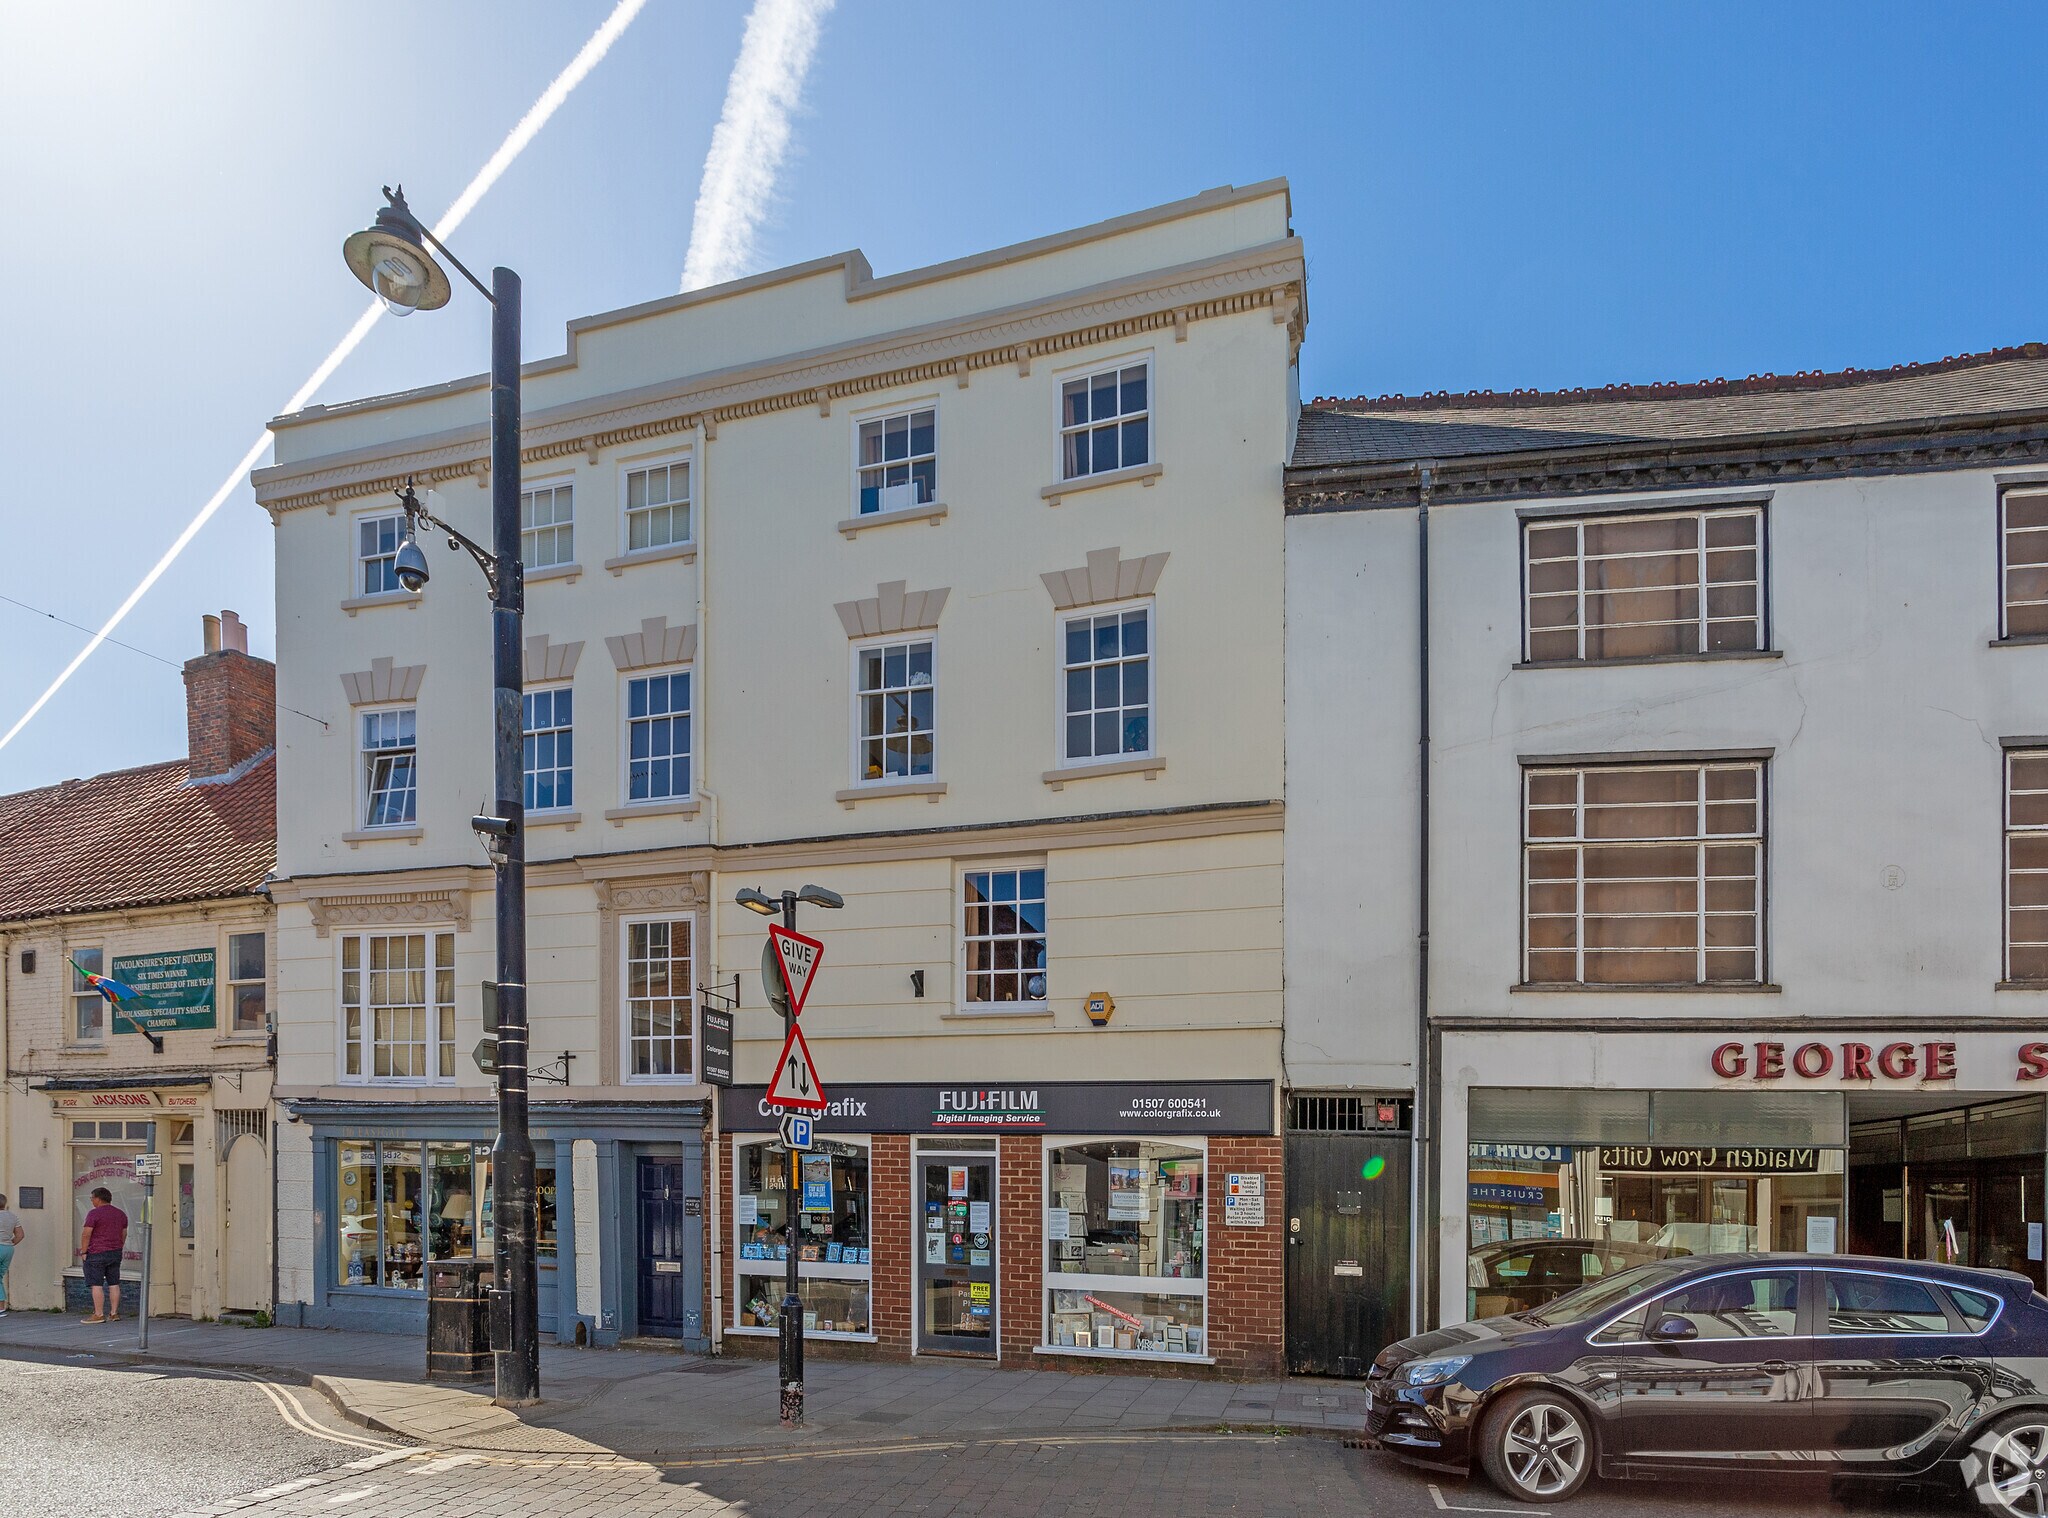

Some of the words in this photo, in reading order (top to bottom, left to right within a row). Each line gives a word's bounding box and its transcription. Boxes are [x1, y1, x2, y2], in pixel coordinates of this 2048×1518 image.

[781, 939, 812, 964] GIVE
[114, 957, 164, 970] LINCOLNSHIRE'S
[164, 956, 181, 966] BEST
[182, 952, 214, 964] BUTCHER
[137, 972, 147, 980] SIX
[147, 971, 164, 979] TIMES
[164, 969, 188, 978] WINNER
[788, 961, 808, 978] WAY
[151, 981, 177, 990] BUTCHER
[199, 977, 214, 986] YEAR
[153, 1006, 186, 1017] SPECIALITY
[185, 1004, 211, 1014] SAUSAGE
[1090, 1001, 1104, 1010] ADT
[146, 1018, 177, 1028] CHAMPION
[706, 1044, 730, 1056] Colorgrafix
[1711, 1042, 1958, 1081] GEORGE
[92, 1093, 151, 1106] JACKSONS
[168, 1097, 198, 1106] BUTCHERS
[938, 1090, 1039, 1111] FUJIFILM
[1132, 1098, 1165, 1109] 01507
[1167, 1098, 1207, 1108] 600541
[936, 1113, 966, 1124] Digital
[967, 1113, 1004, 1124] Imaging
[1005, 1113, 1041, 1123] Service
[1119, 1109, 1221, 1119] www.colorgrafix.co.uk
[89, 1167, 115, 1182] BUTCHER
[115, 1168, 125, 1177] OF
[1100, 1301, 1127, 1319] CLEARANCE
[1126, 1314, 1141, 1326] LINES
